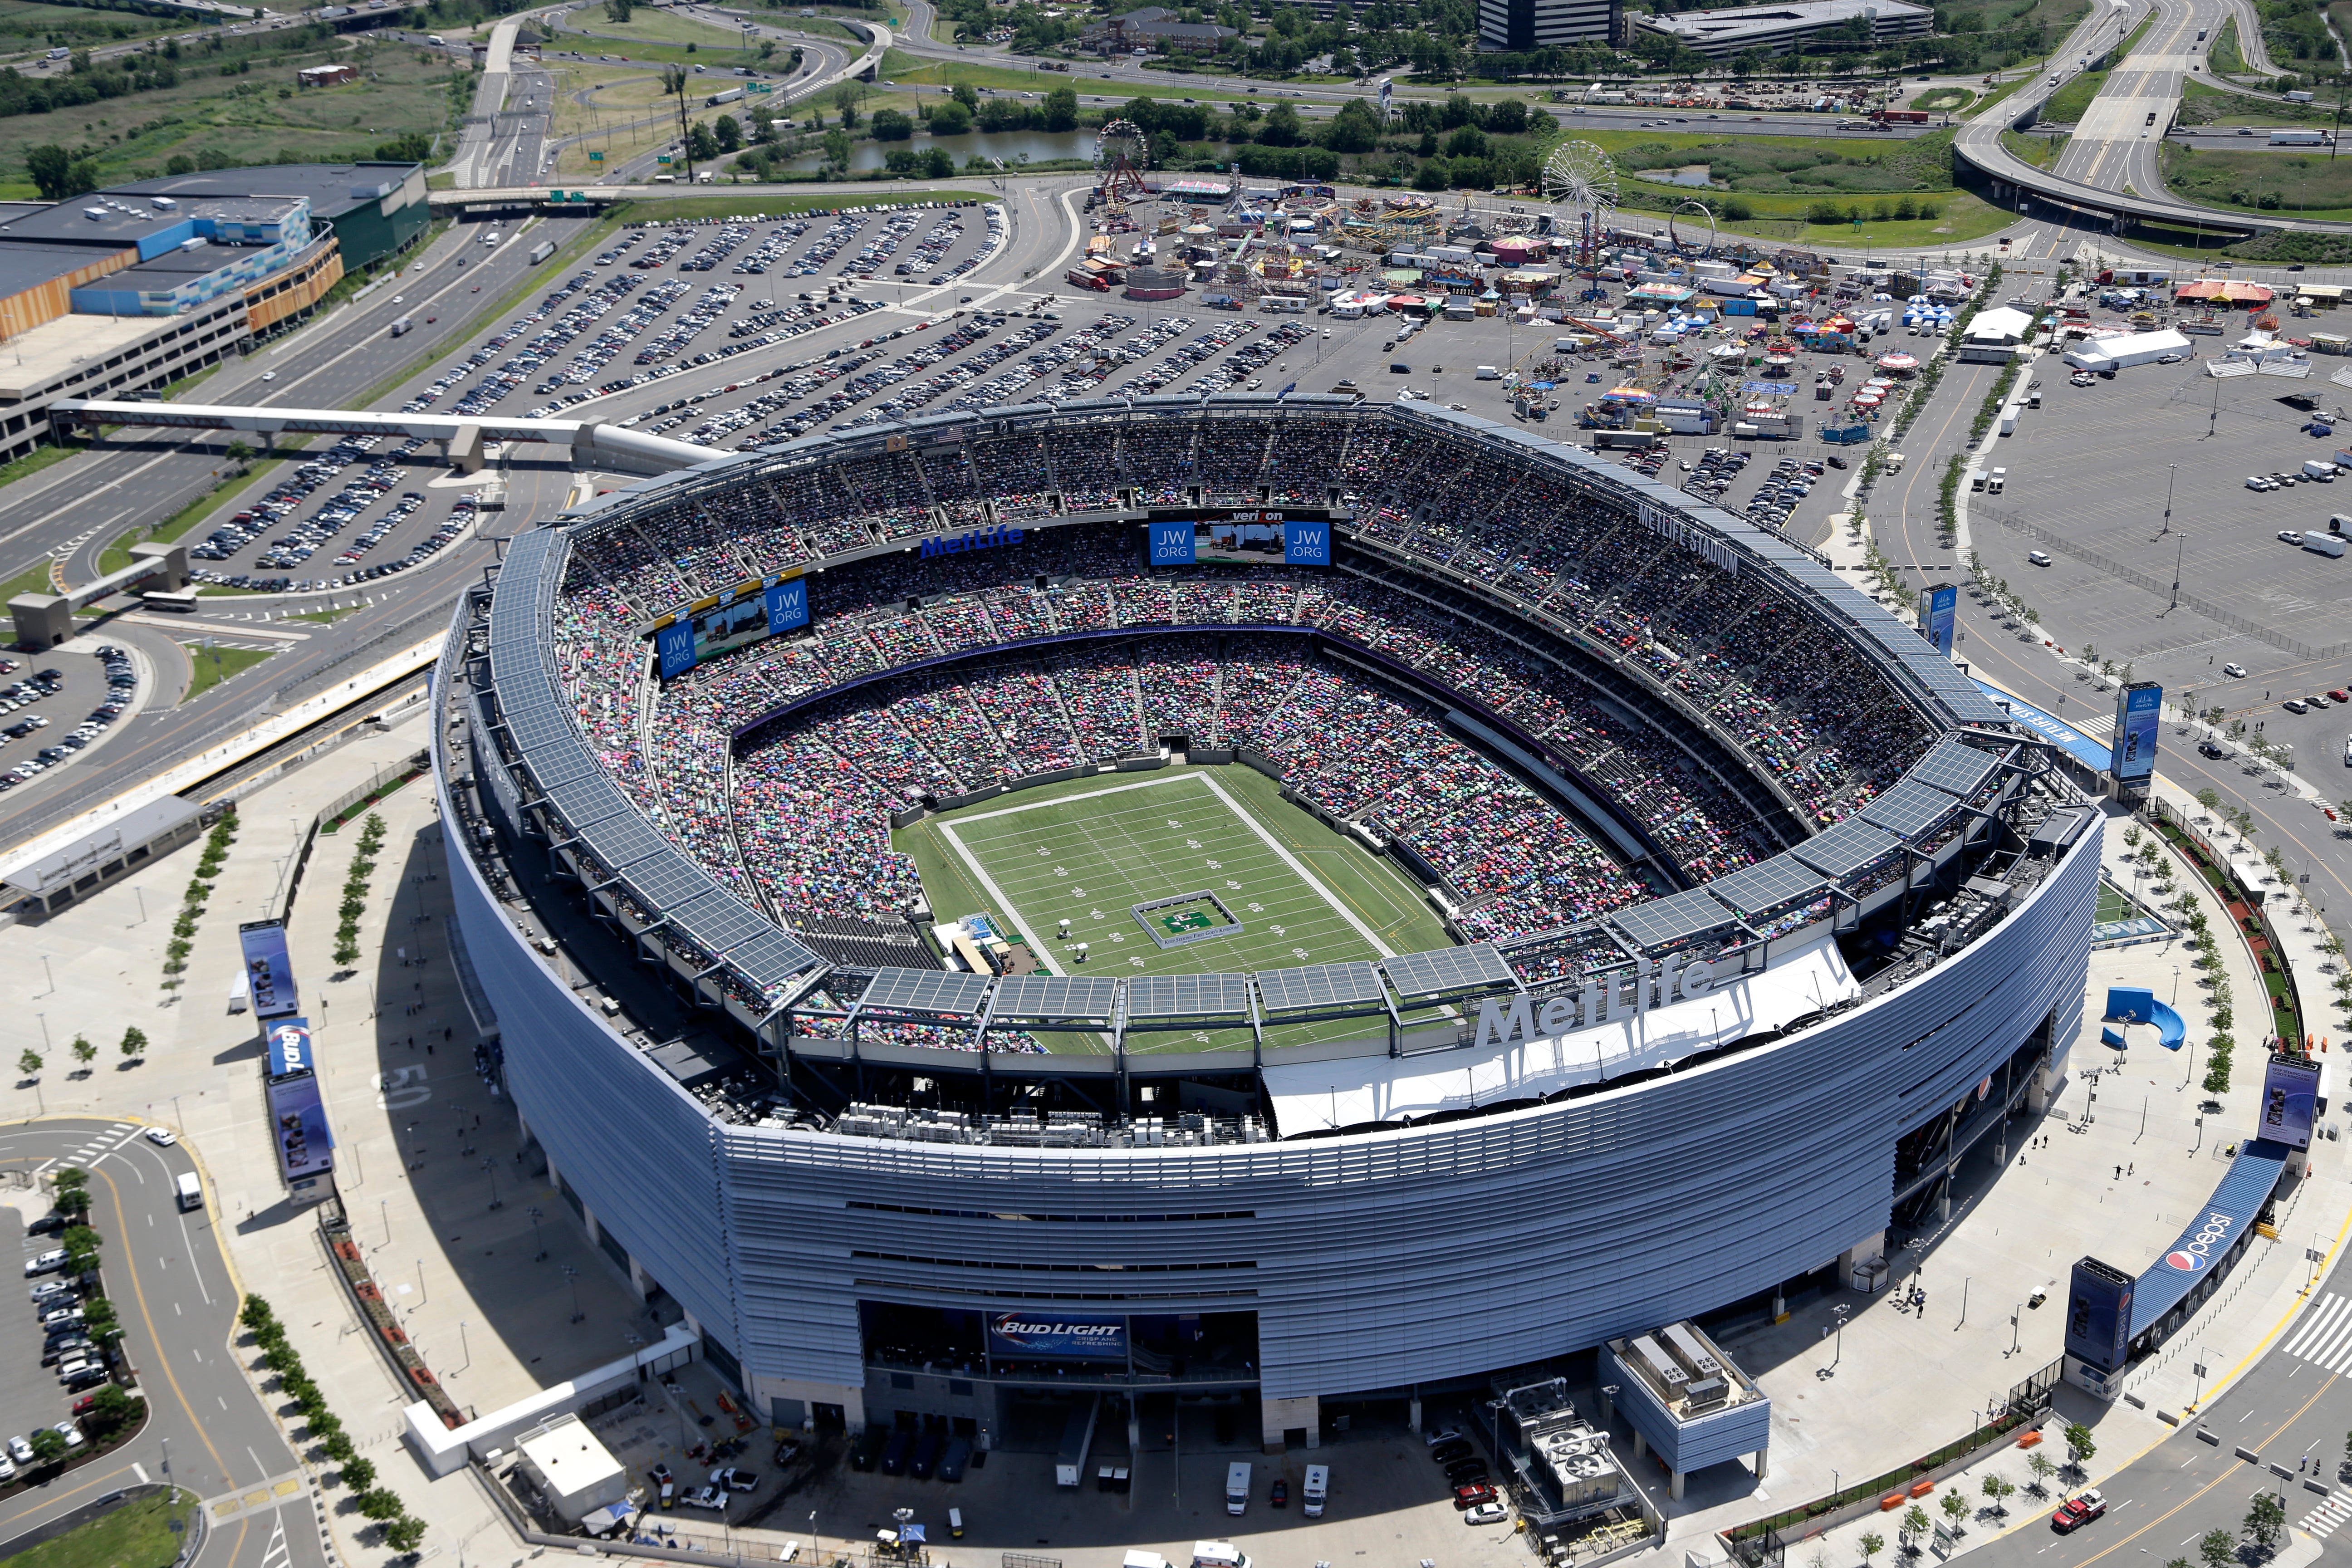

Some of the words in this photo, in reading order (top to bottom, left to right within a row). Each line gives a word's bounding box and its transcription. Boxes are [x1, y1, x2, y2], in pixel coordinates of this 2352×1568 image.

[1233, 510, 1283, 523] verizon
[920, 524, 1024, 559] MetLife
[1158, 530, 1186, 545] JW
[1293, 530, 1322, 545] JW
[1638, 505, 1686, 547] METLIFE
[1690, 529, 1738, 577] STADIUM
[1156, 546, 1187, 558] .ORG
[1291, 546, 1322, 558] .ORG
[763, 578, 778, 589] SAP
[720, 592, 734, 604] SAP
[774, 590, 799, 612] JW
[773, 608, 802, 626] .ORG
[666, 631, 687, 655] JW
[665, 653, 690, 669] .ORG
[2027, 716, 2079, 742] METLIFE
[1474, 952, 1715, 1049] MetLife
[1191, 1031, 1209, 1042] 10
[281, 1032, 302, 1063] BUD
[2188, 1212, 2233, 1257] pepsi
[1000, 1321, 1052, 1334] BUD
[1052, 1323, 1121, 1336] LIGHT
[2117, 1314, 2127, 1349] pepsi
